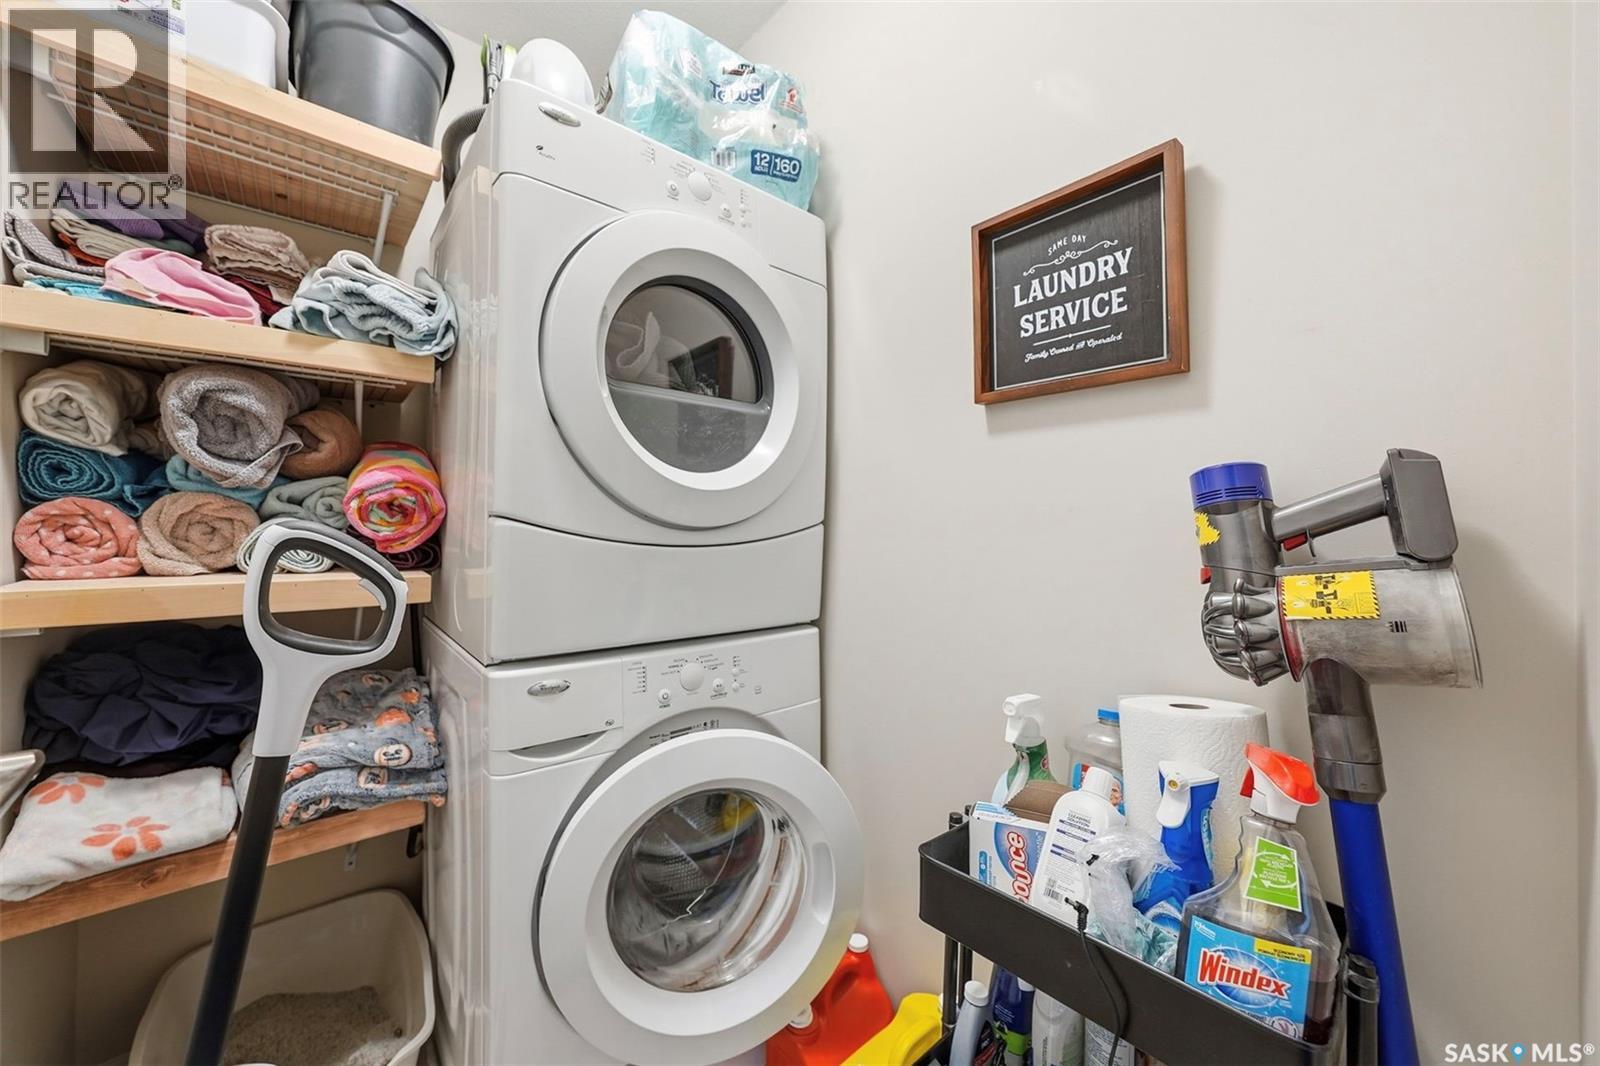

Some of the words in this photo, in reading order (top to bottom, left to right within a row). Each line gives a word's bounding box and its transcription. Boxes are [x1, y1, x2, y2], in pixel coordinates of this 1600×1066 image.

[754, 151, 770, 166] 12
[774, 157, 800, 175] 160
[1048, 236, 1068, 256] SAME
[1071, 234, 1087, 244] DAY
[1013, 246, 1133, 308] LAUNDRY
[1019, 286, 1128, 338] SERVICE
[1024, 350, 1050, 363] Family
[1049, 343, 1075, 356] Owned
[1087, 332, 1123, 349] Operated
[1006, 831, 1033, 904] ounce
[1199, 949, 1289, 997] Windex
